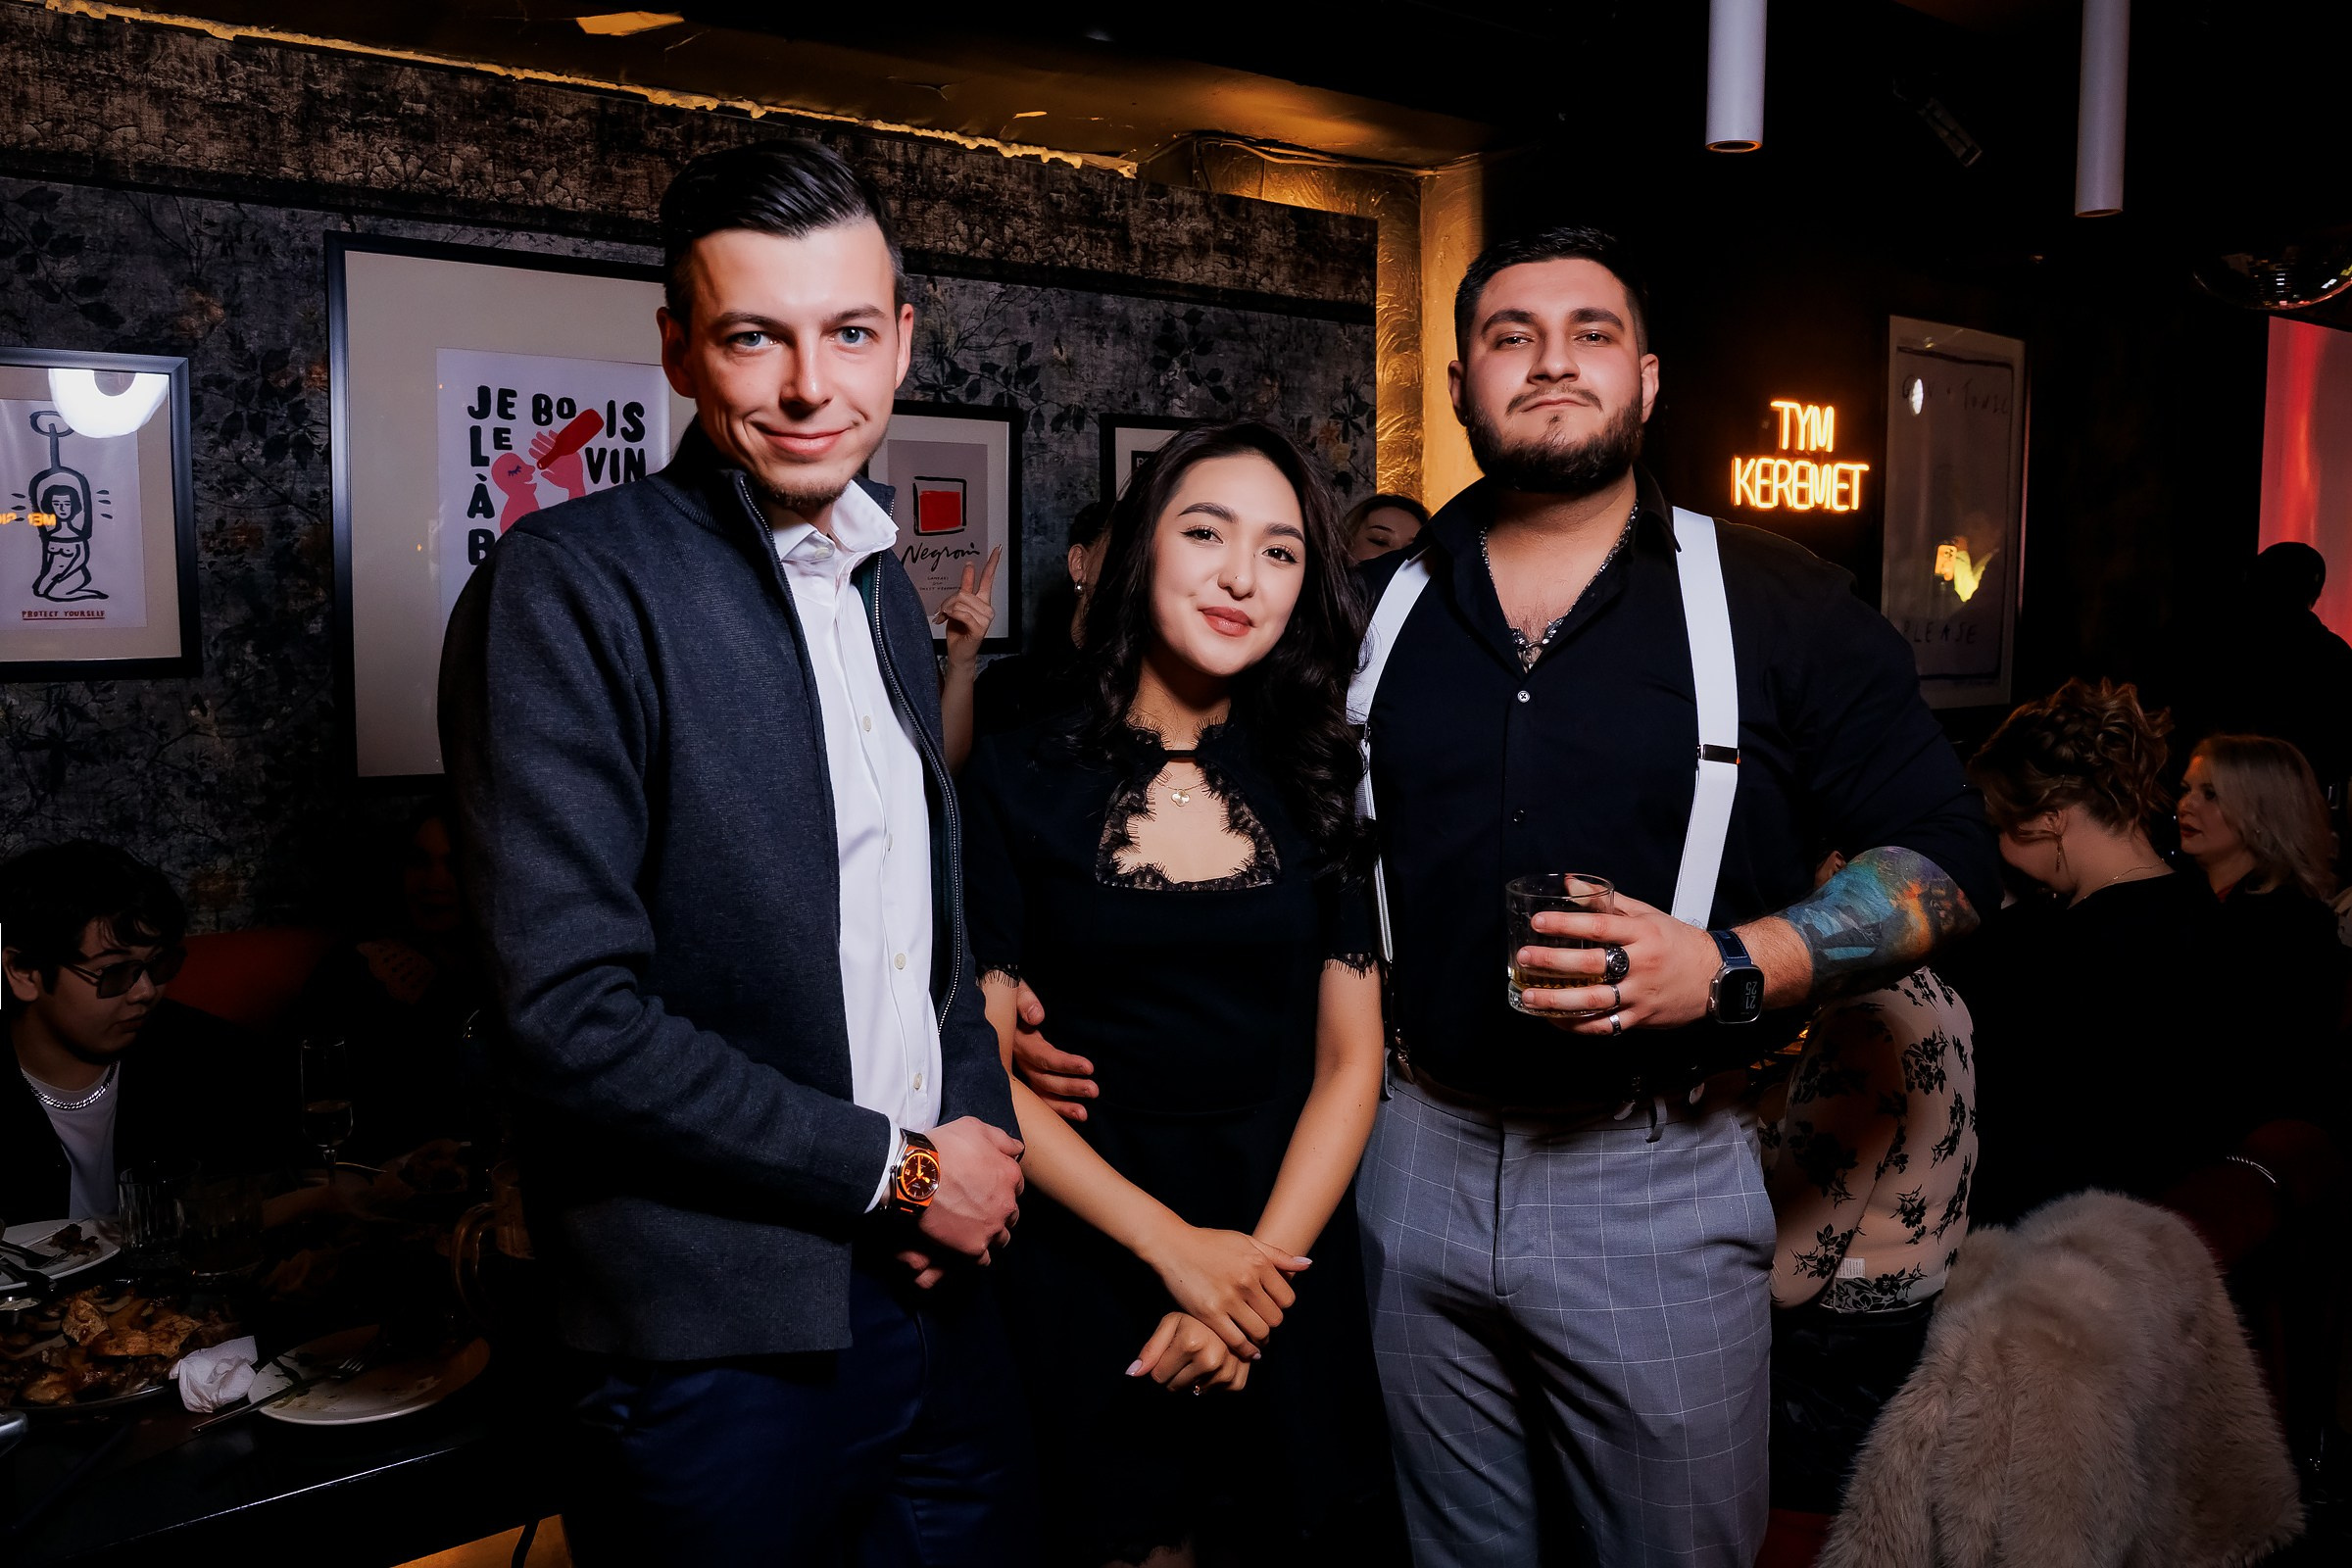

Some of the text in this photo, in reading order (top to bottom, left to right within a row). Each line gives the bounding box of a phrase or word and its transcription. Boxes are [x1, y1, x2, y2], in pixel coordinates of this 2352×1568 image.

[466, 385, 518, 420] JE
[1770, 400, 1836, 453] TYM
[469, 425, 647, 484] LE VIN
[466, 473, 496, 519] À
[1732, 457, 1870, 512] KEREMET
[901, 543, 980, 571] Negroni
[1903, 620, 1978, 644] PLEASE
[1745, 982, 1757, 995] 25
[1745, 996, 1756, 1008] 21
